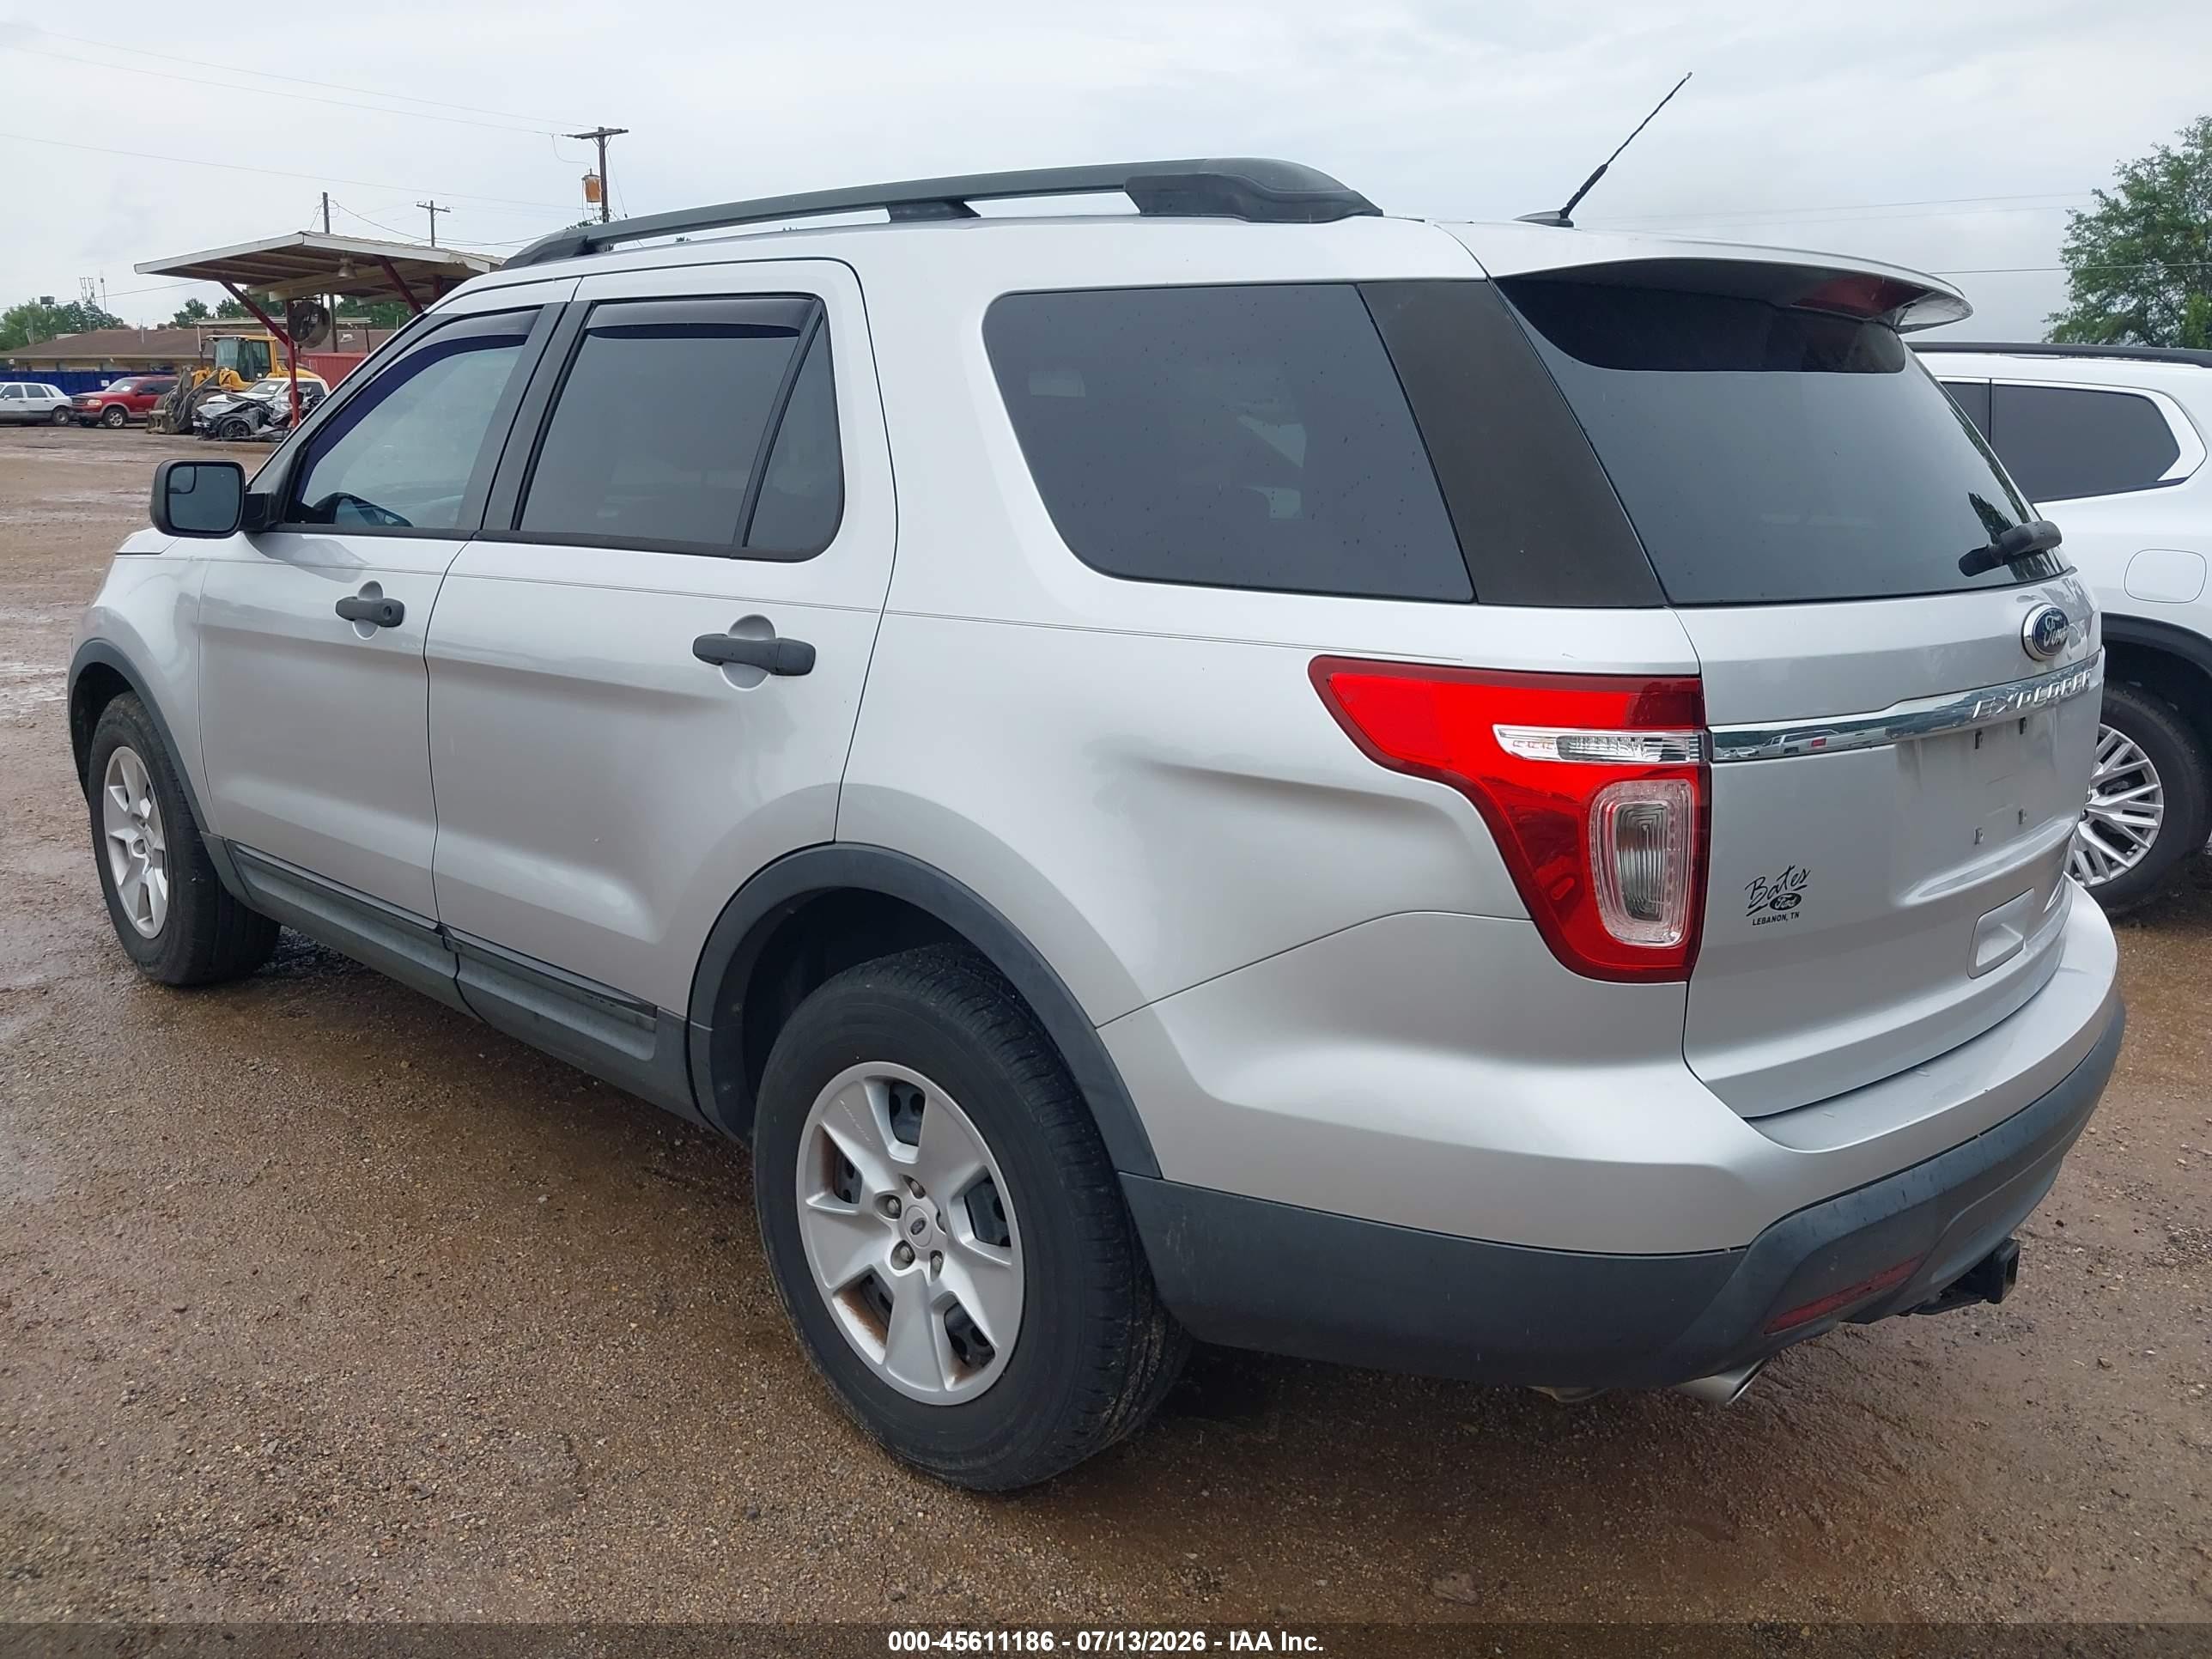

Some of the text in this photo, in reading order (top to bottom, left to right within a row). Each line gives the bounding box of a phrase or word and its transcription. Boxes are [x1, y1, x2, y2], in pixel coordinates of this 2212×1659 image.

[2044, 616, 2069, 647] Ford
[1972, 668, 2092, 719] EXPLORER
[1745, 865, 1811, 909] Bates
[1752, 911, 1800, 926] LEBANON, TN
